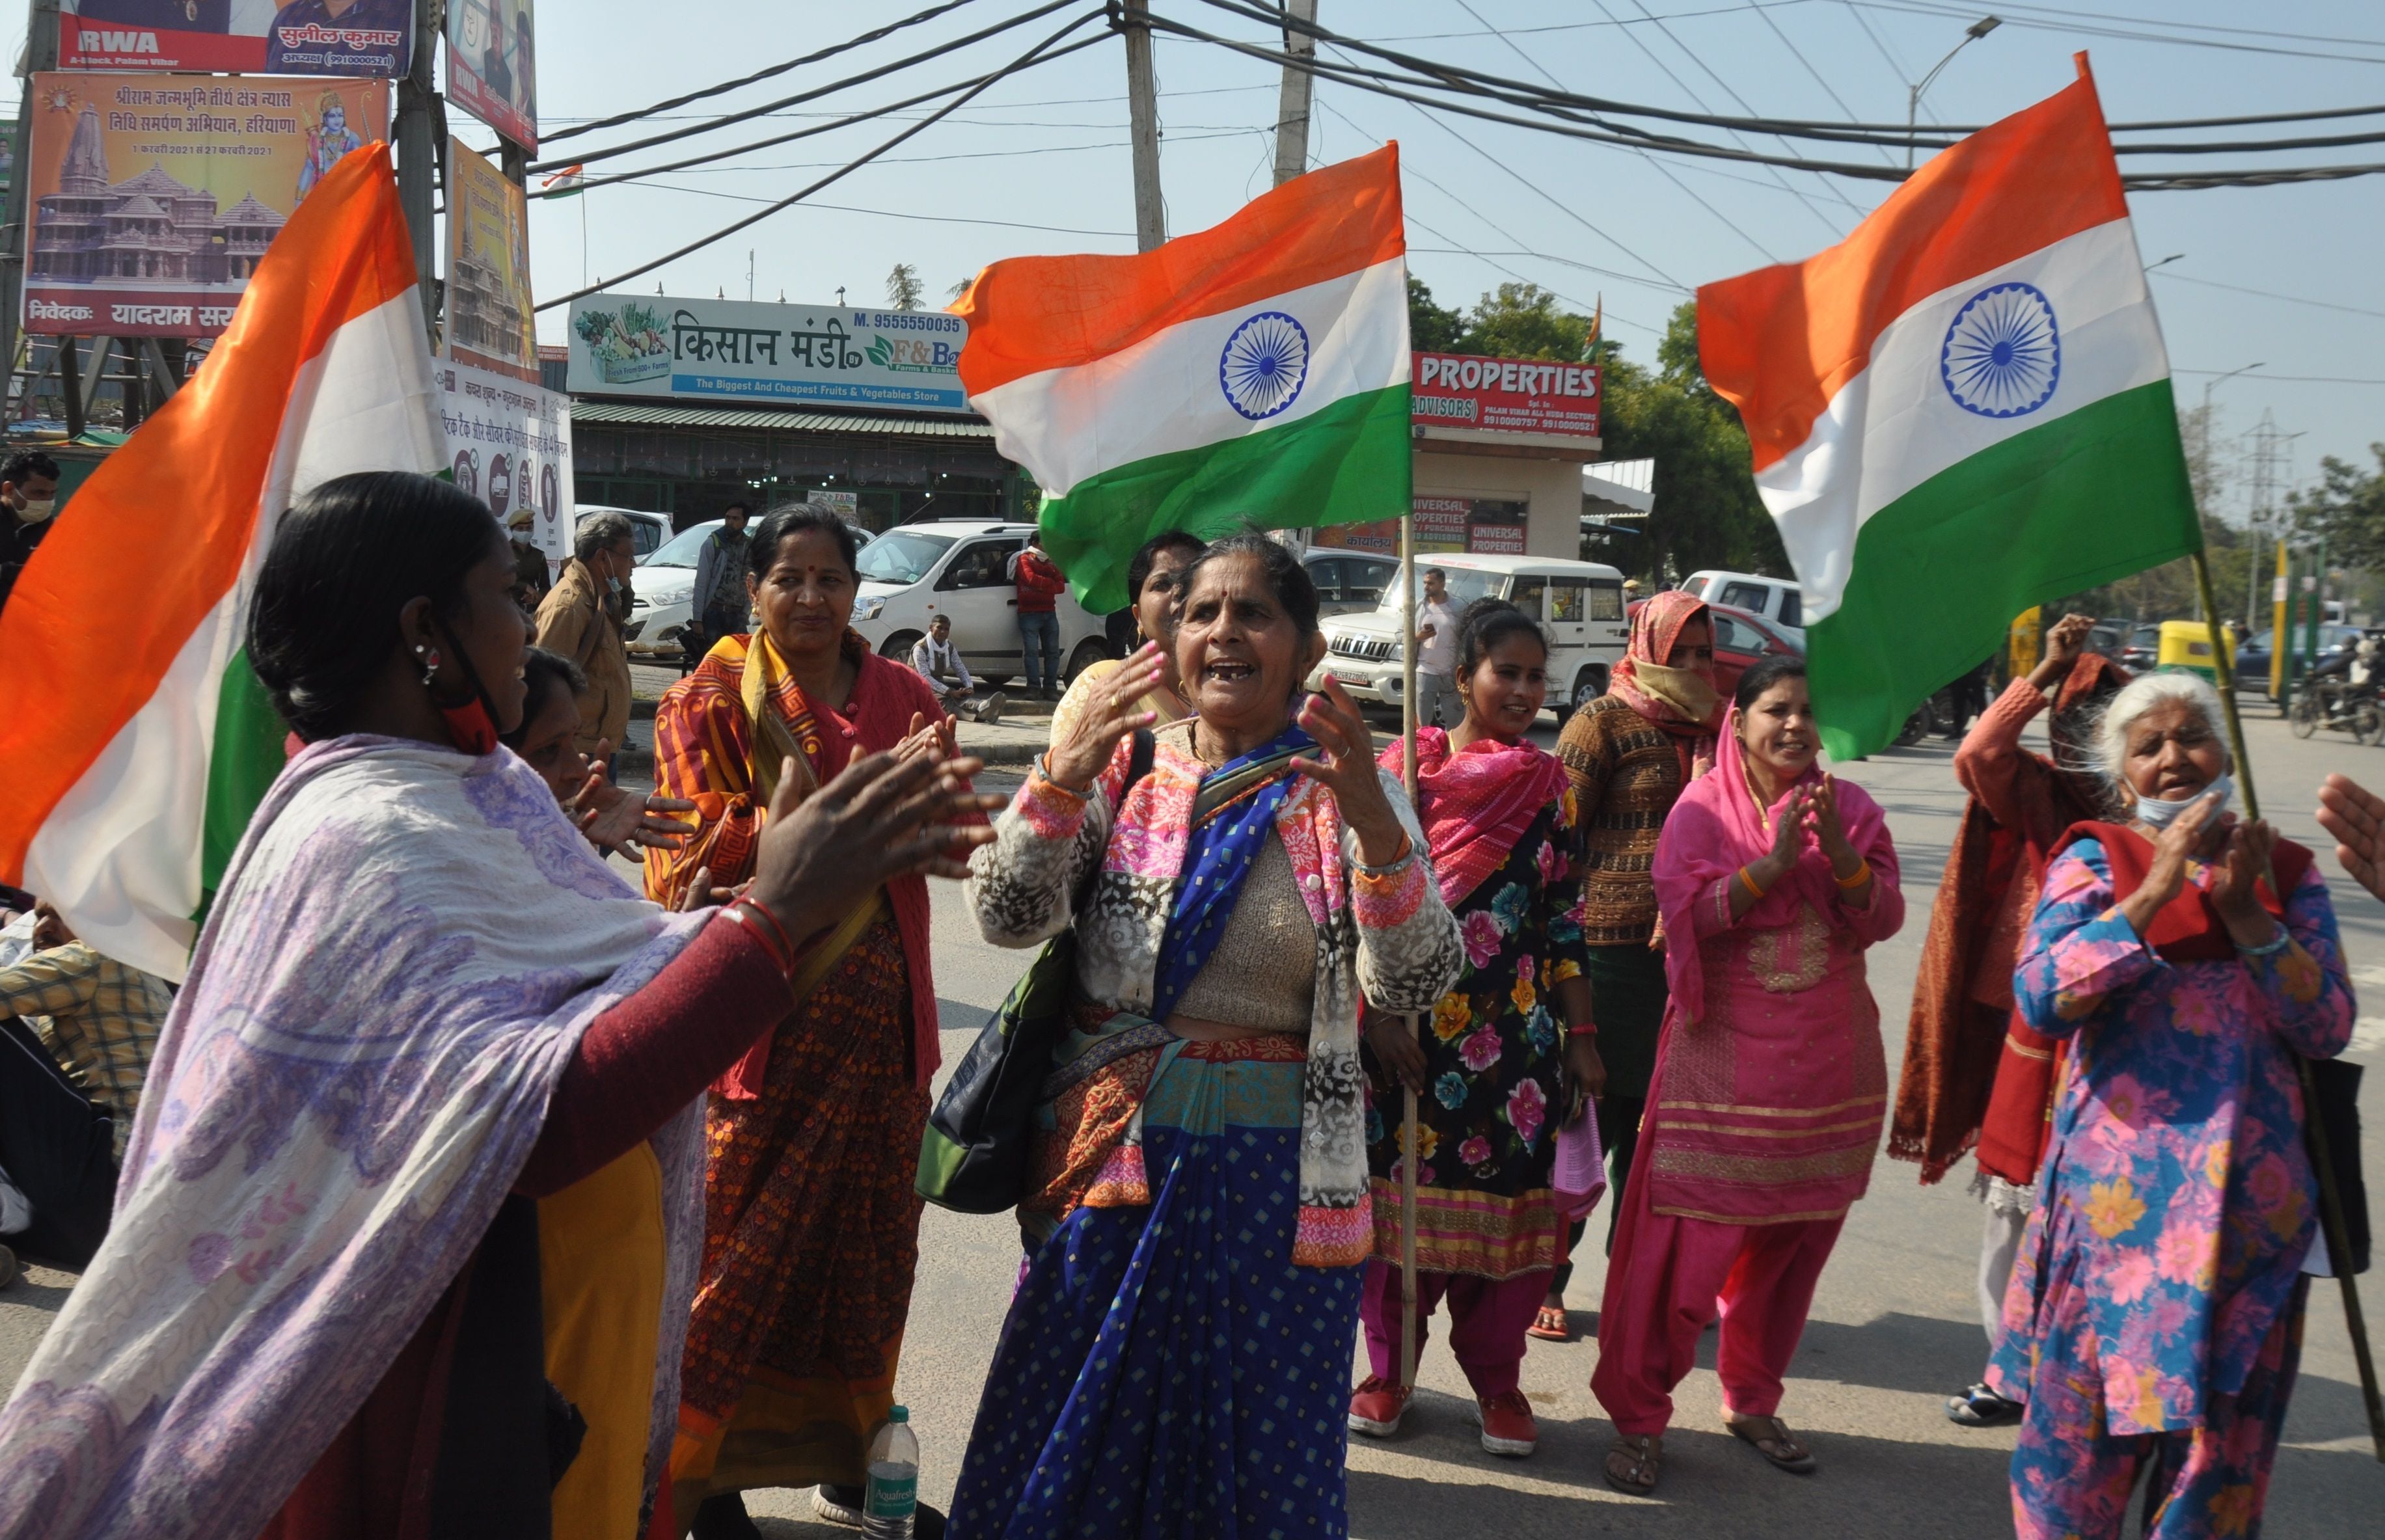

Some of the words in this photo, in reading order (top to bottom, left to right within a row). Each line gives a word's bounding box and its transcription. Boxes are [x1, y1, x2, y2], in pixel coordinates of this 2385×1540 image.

[78, 31, 159, 53] RWA
[279, 23, 340, 48] सुनील
[342, 29, 402, 50] कुमार
[282, 53, 323, 63] अध्यक्ष
[456, 64, 478, 98] RWA
[115, 86, 152, 105] श्रीराम
[156, 87, 206, 111] जन्मभूमि
[210, 87, 233, 106] तीर्थ
[238, 88, 258, 107] क्षेत्र
[262, 92, 291, 107] न्यास
[109, 112, 137, 131] निधि
[141, 114, 182, 131] समर्पण
[246, 115, 296, 133] हरियाणा
[169, 146, 194, 155] 2021
[205, 146, 217, 155] 27
[247, 146, 271, 155] 2021
[111, 303, 193, 325] यादराम
[198, 306, 236, 326] सर
[854, 312, 869, 327] M.
[875, 314, 960, 332] 9555550035
[672, 310, 782, 365] किसान
[791, 317, 851, 369] मंडी
[849, 355, 860, 365] By
[1421, 357, 1596, 397] PROPERTIES
[696, 379, 713, 388] The
[716, 379, 752, 391] Biggest
[754, 382, 772, 392] And
[775, 383, 817, 395] Cheapest
[821, 385, 847, 396] Fruits
[850, 387, 858, 396] &
[861, 388, 912, 401] Vegetables
[914, 391, 939, 401] Store
[1485, 406, 1507, 414] PALAM
[1566, 412, 1596, 421] SECTORS
[472, 415, 485, 440] और
[485, 418, 504, 444] सीवर
[549, 435, 554, 455] 4
[1542, 419, 1594, 431] 9910000521
[1412, 499, 1465, 511] IVERSAL
[1346, 532, 1392, 547] कार्यालय
[1473, 526, 1523, 539] UNIVERSAL
[1473, 540, 1523, 552] PROPERTIES
[877, 1487, 912, 1502] Aquafresh
